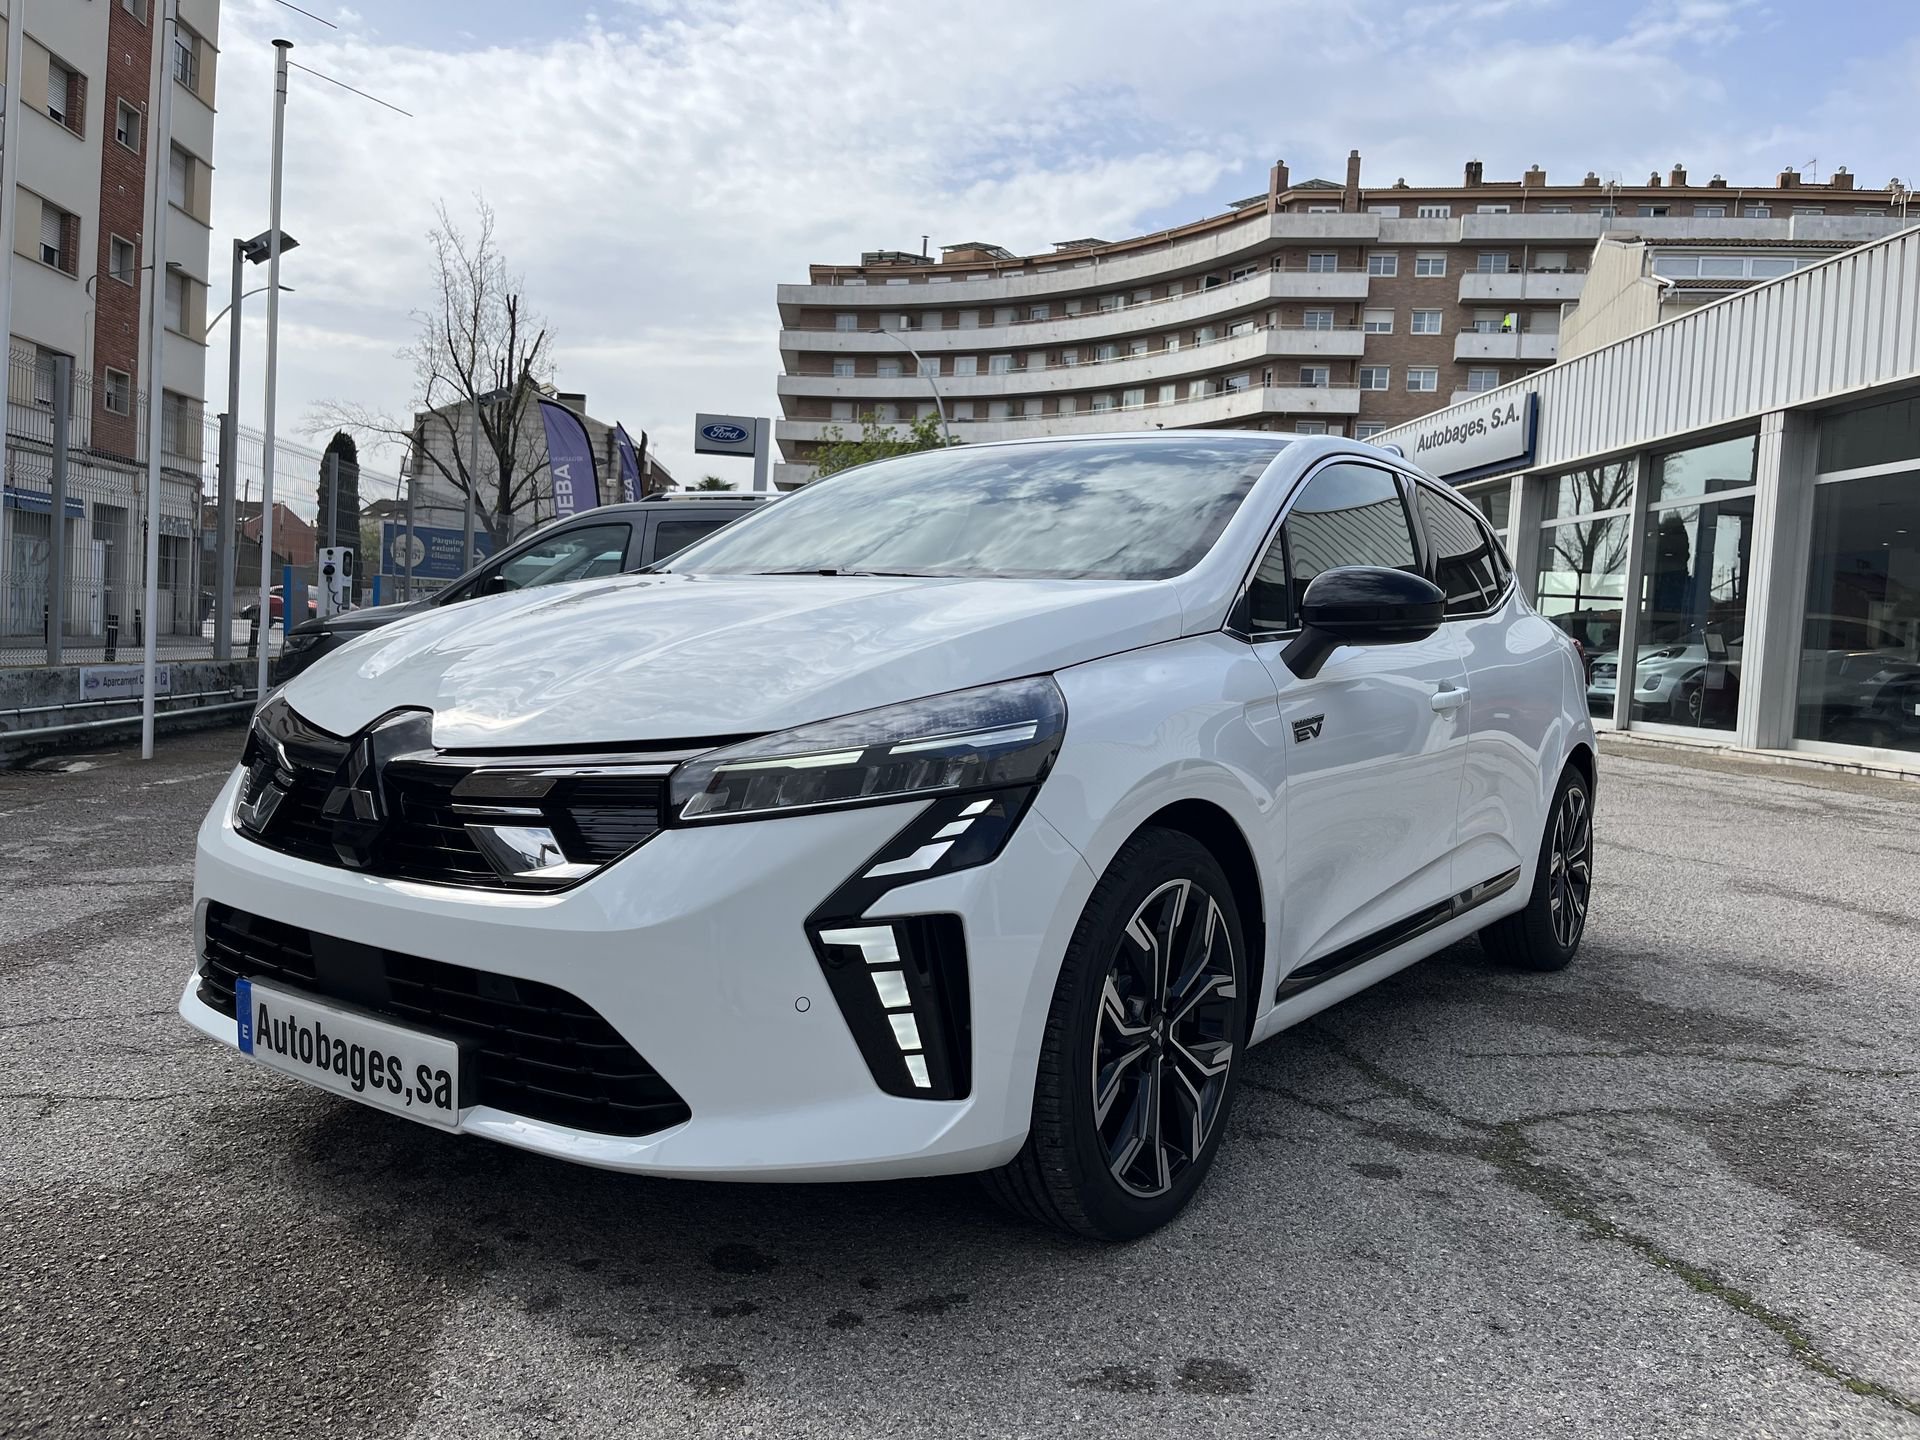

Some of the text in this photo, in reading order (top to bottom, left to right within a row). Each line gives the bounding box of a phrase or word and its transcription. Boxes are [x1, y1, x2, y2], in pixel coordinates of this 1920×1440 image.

[710, 425, 740, 439] Ford
[1417, 402, 1520, 453] Autobages, S.A.
[103, 675, 138, 688] Aparcament
[242, 1023, 249, 1040] E
[256, 1002, 452, 1111] Autobages,sa
